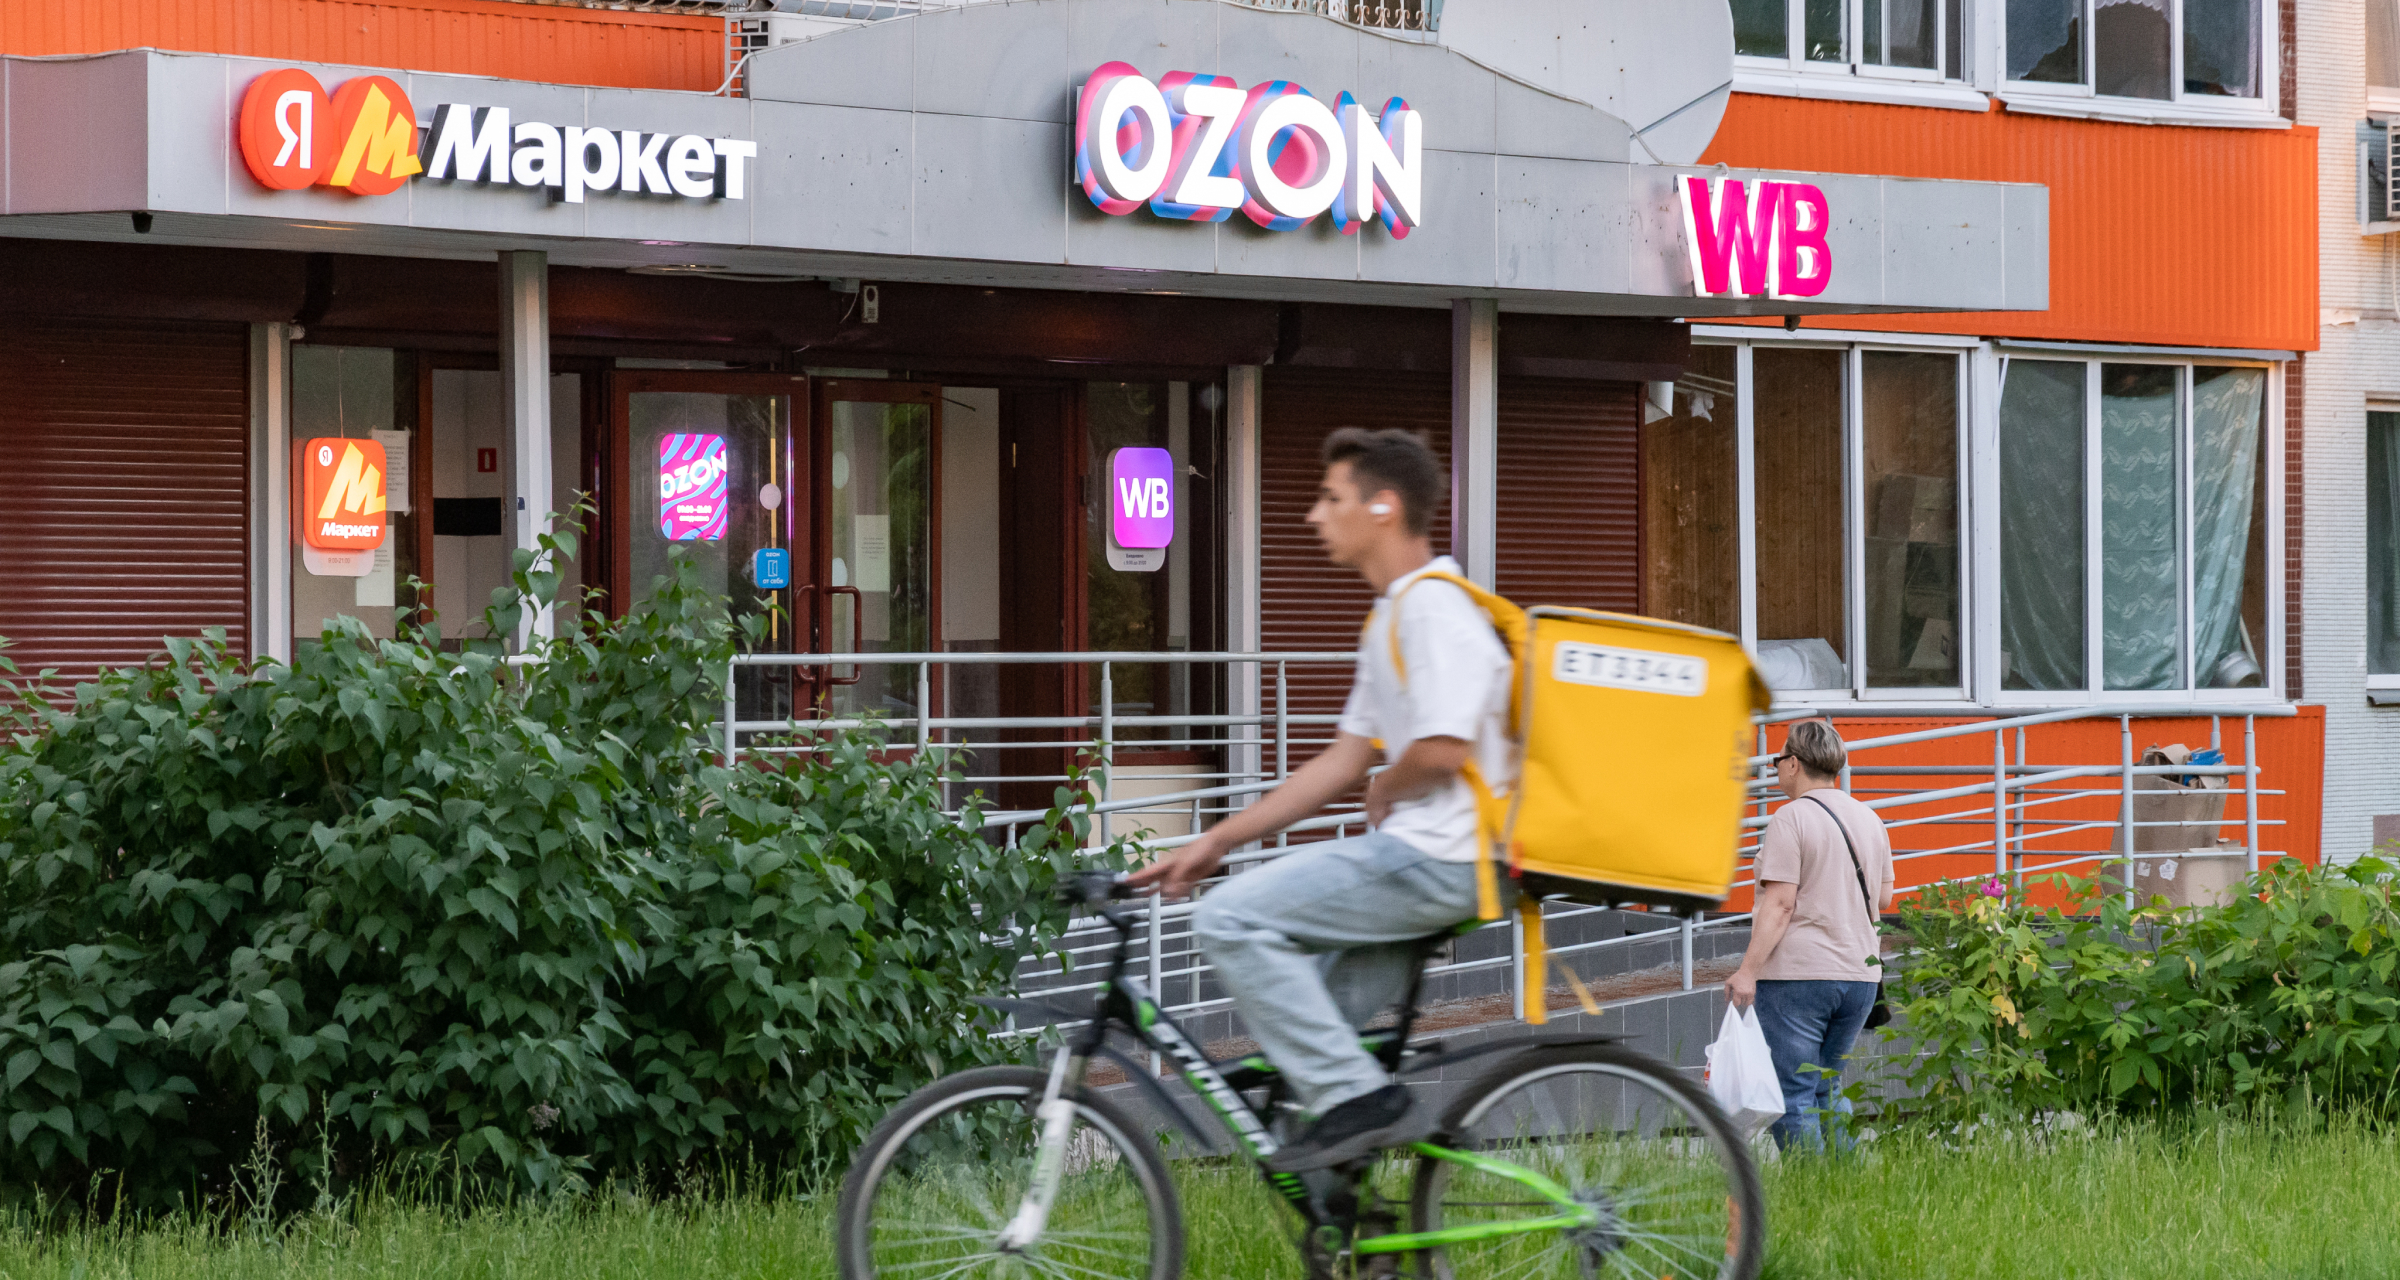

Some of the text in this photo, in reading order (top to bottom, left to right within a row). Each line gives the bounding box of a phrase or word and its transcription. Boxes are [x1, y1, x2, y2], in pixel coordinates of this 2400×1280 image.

[274, 90, 312, 169] Я
[425, 103, 757, 204] Маркет
[1085, 74, 1423, 230] OZON
[1677, 174, 1832, 300] WB
[660, 450, 728, 499] OZON
[1118, 477, 1170, 518] WB
[321, 522, 379, 539] Маркет
